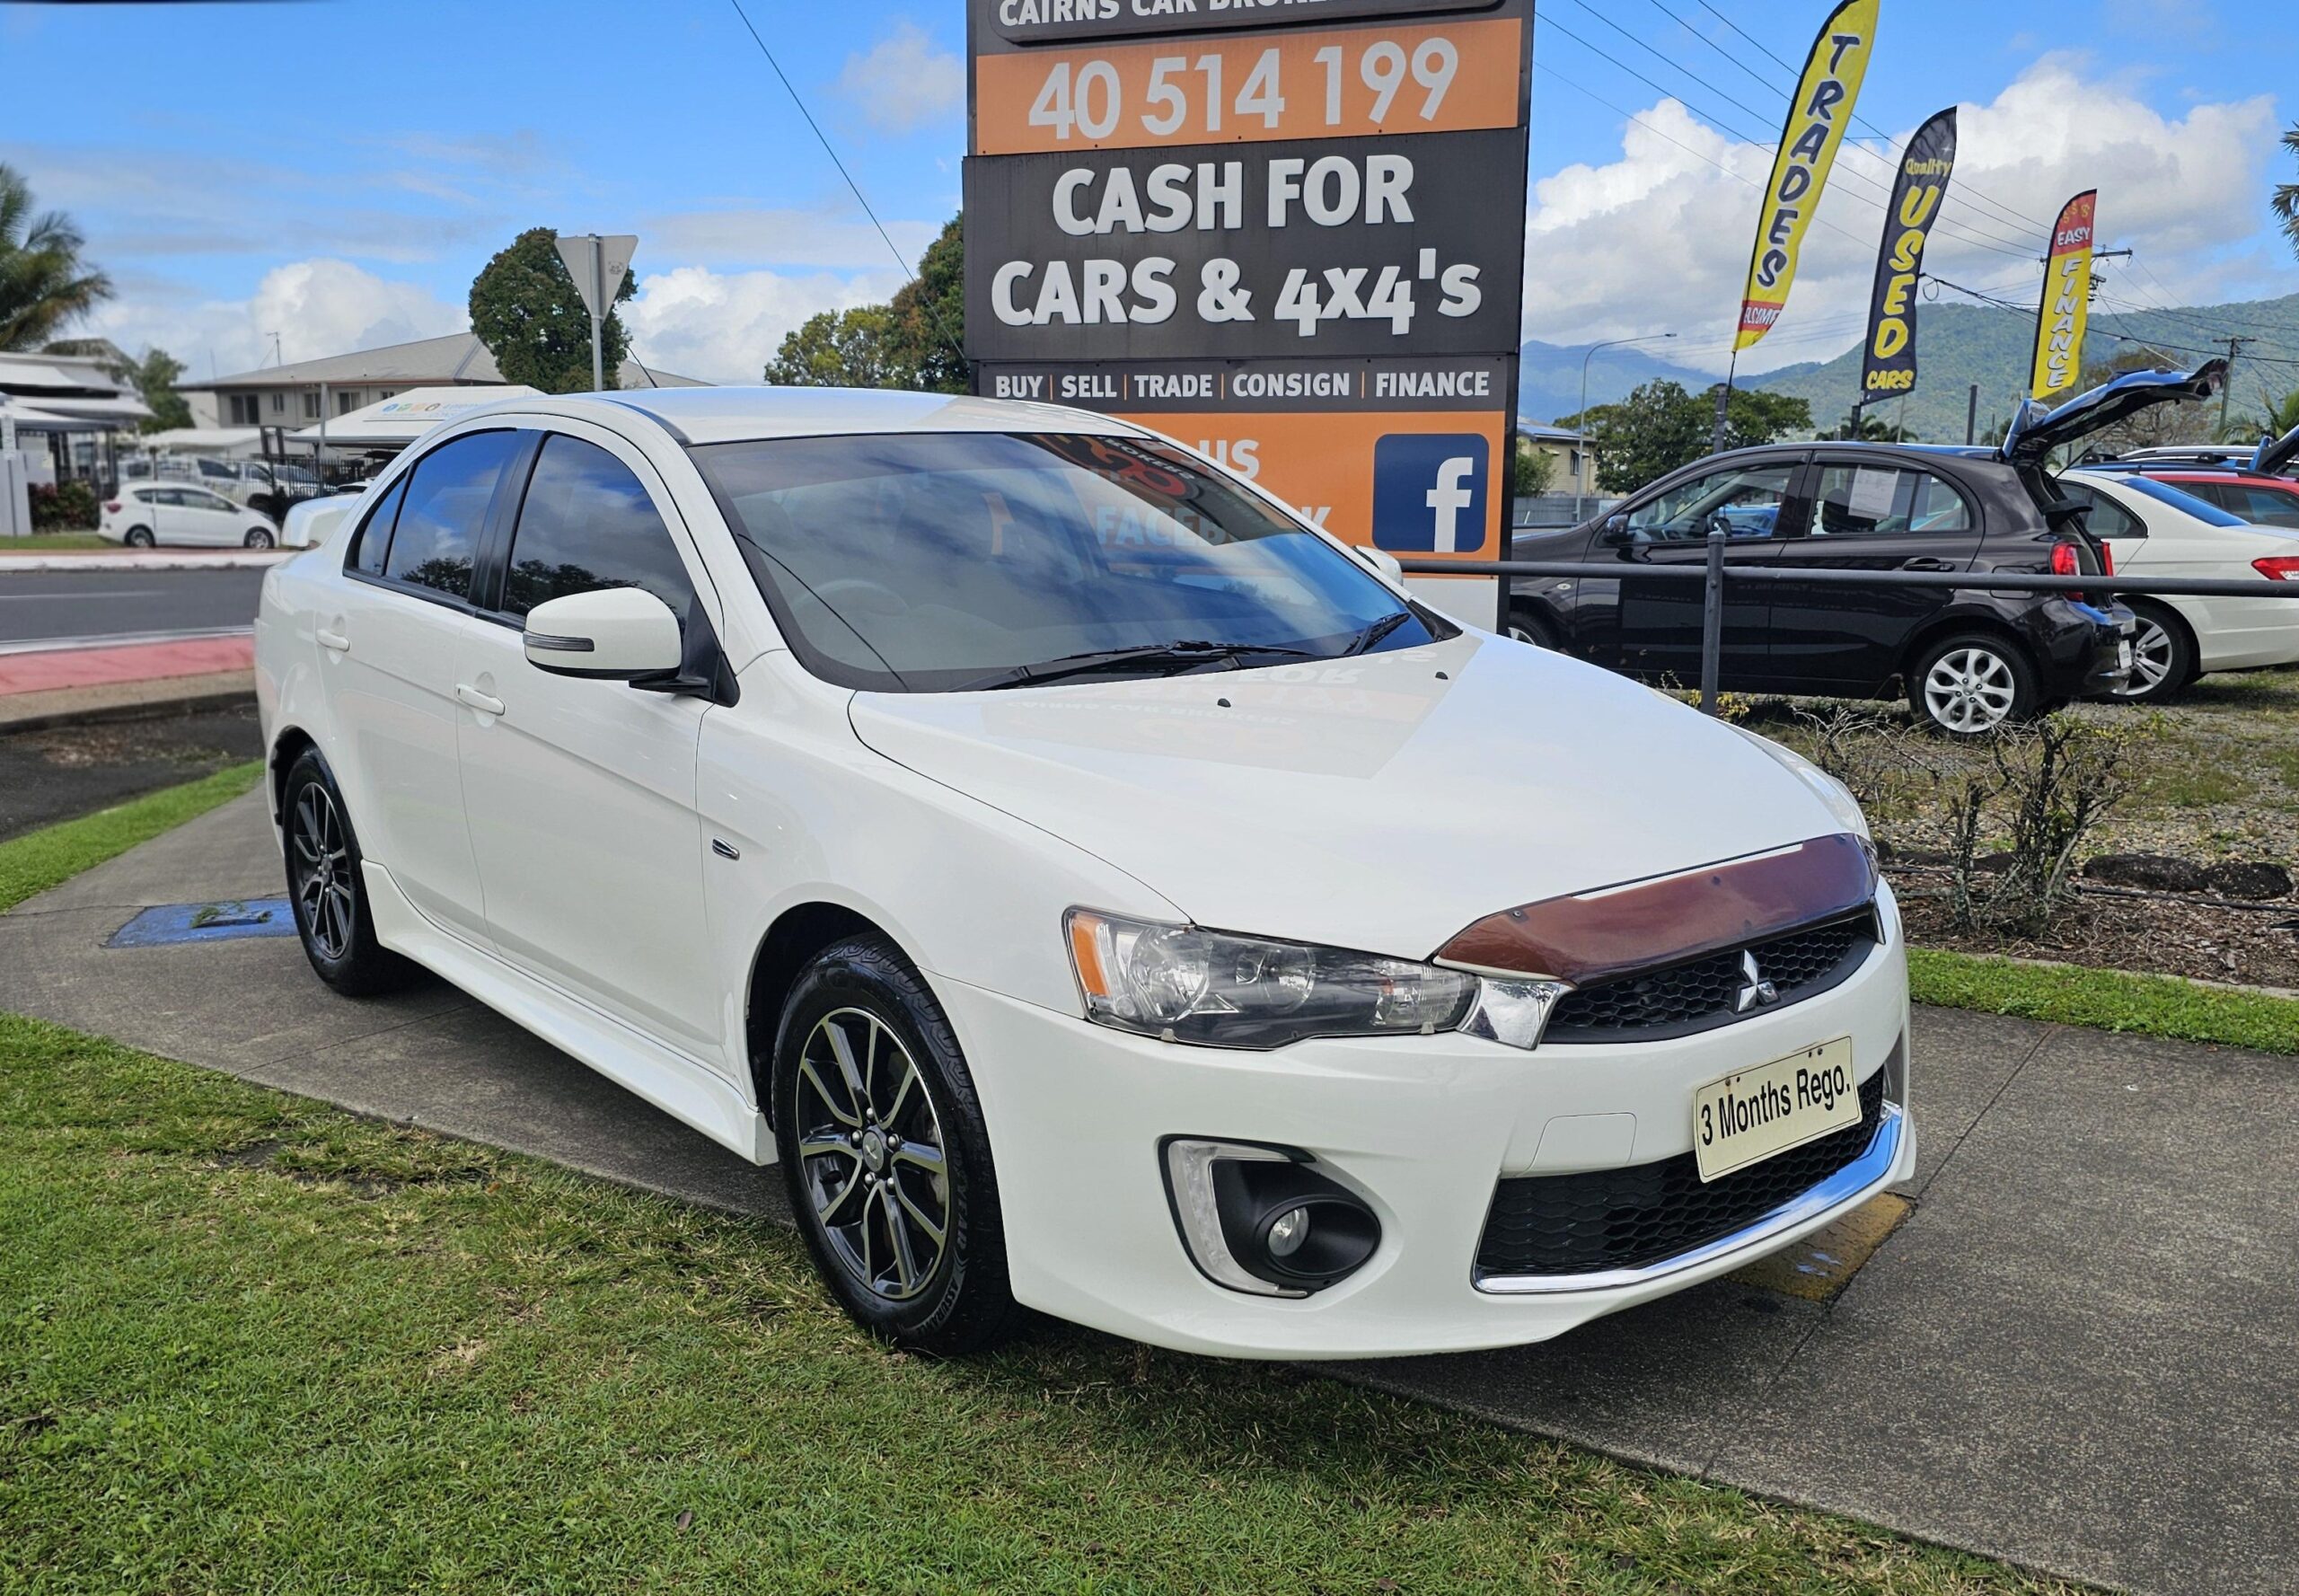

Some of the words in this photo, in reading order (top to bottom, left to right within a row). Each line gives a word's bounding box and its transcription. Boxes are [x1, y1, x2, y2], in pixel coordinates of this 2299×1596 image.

[999, 0, 1120, 26] CAIRNS
[1028, 60, 1121, 140] 40
[1141, 48, 1285, 136] 514
[1314, 37, 1458, 125] 199
[1053, 162, 1243, 236] CASH
[1267, 154, 1414, 228] FOR
[1757, 35, 1861, 287] TRADES
[1905, 158, 1952, 178] Quality
[1873, 185, 1940, 359] USED
[2057, 227, 2091, 246] EASY
[991, 256, 1177, 326] CARS
[1196, 258, 1255, 322] &
[2047, 259, 2083, 388] FINANCE
[995, 375, 1043, 398] BUY
[1061, 375, 1117, 399] SELL
[1133, 374, 1213, 398] TRADE
[1232, 373, 1350, 397] CONSIGN
[1376, 371, 1490, 397] FINANCE
[1866, 370, 1915, 391] CARS
[1700, 1104, 1713, 1146] 3
[1718, 1080, 1792, 1139] Months
[1796, 1064, 1851, 1111] Rego.
